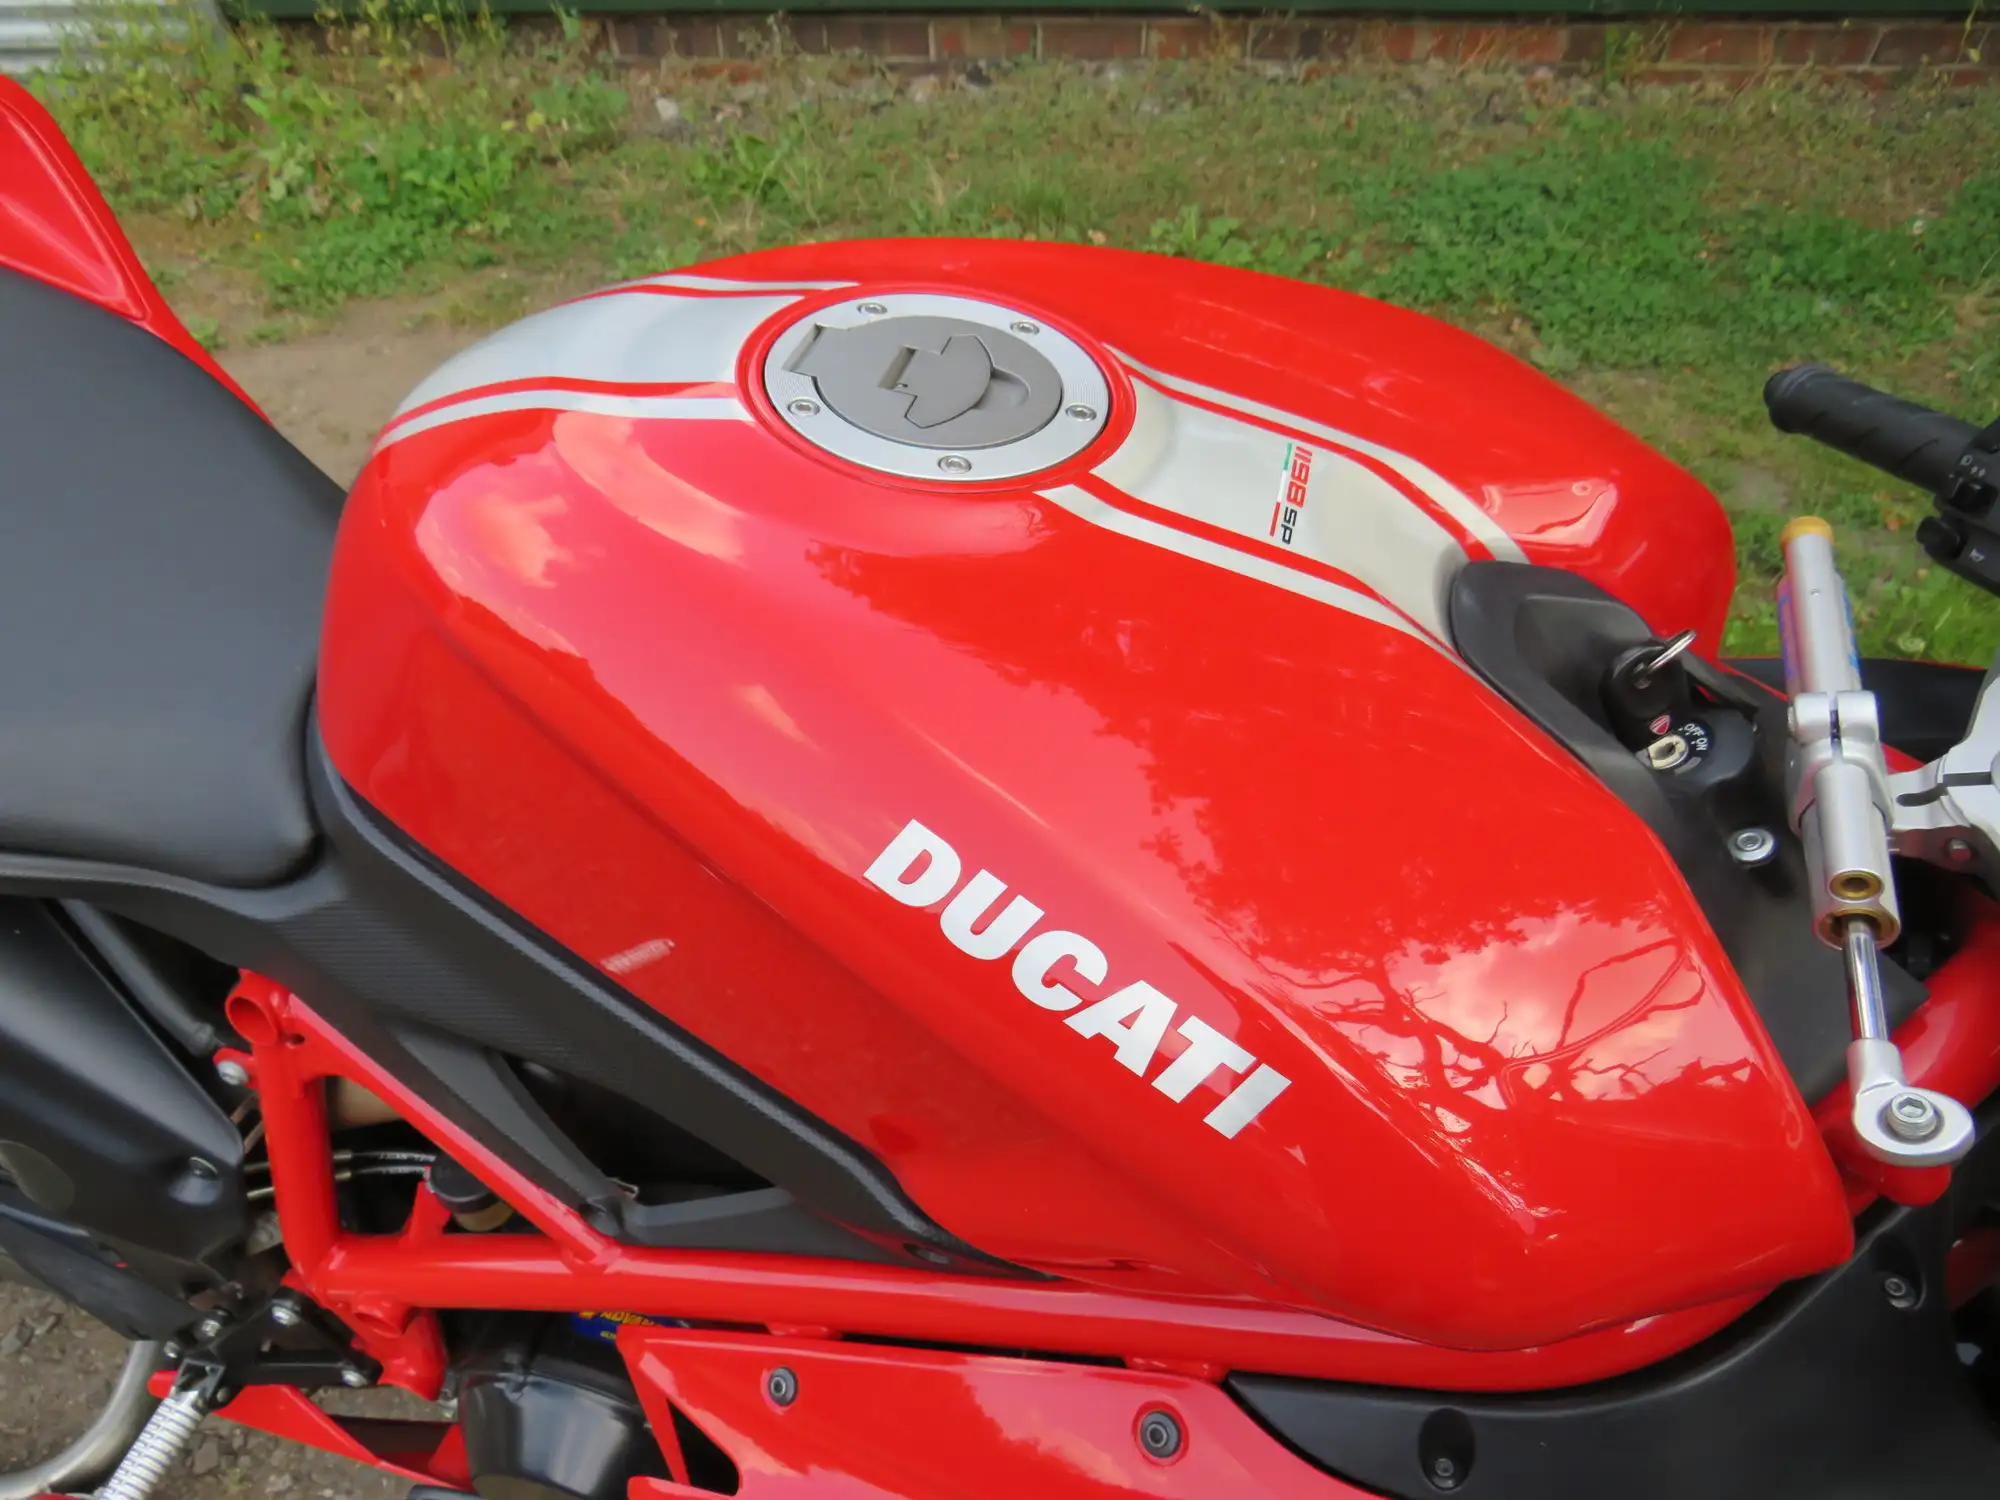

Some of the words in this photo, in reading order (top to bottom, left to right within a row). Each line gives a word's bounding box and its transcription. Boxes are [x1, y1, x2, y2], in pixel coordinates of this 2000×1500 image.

[1287, 446, 1312, 508] 1198
[1684, 723, 1705, 736] OFF
[1696, 738, 1708, 751] ON
[863, 818, 1292, 1139] DUCATI
